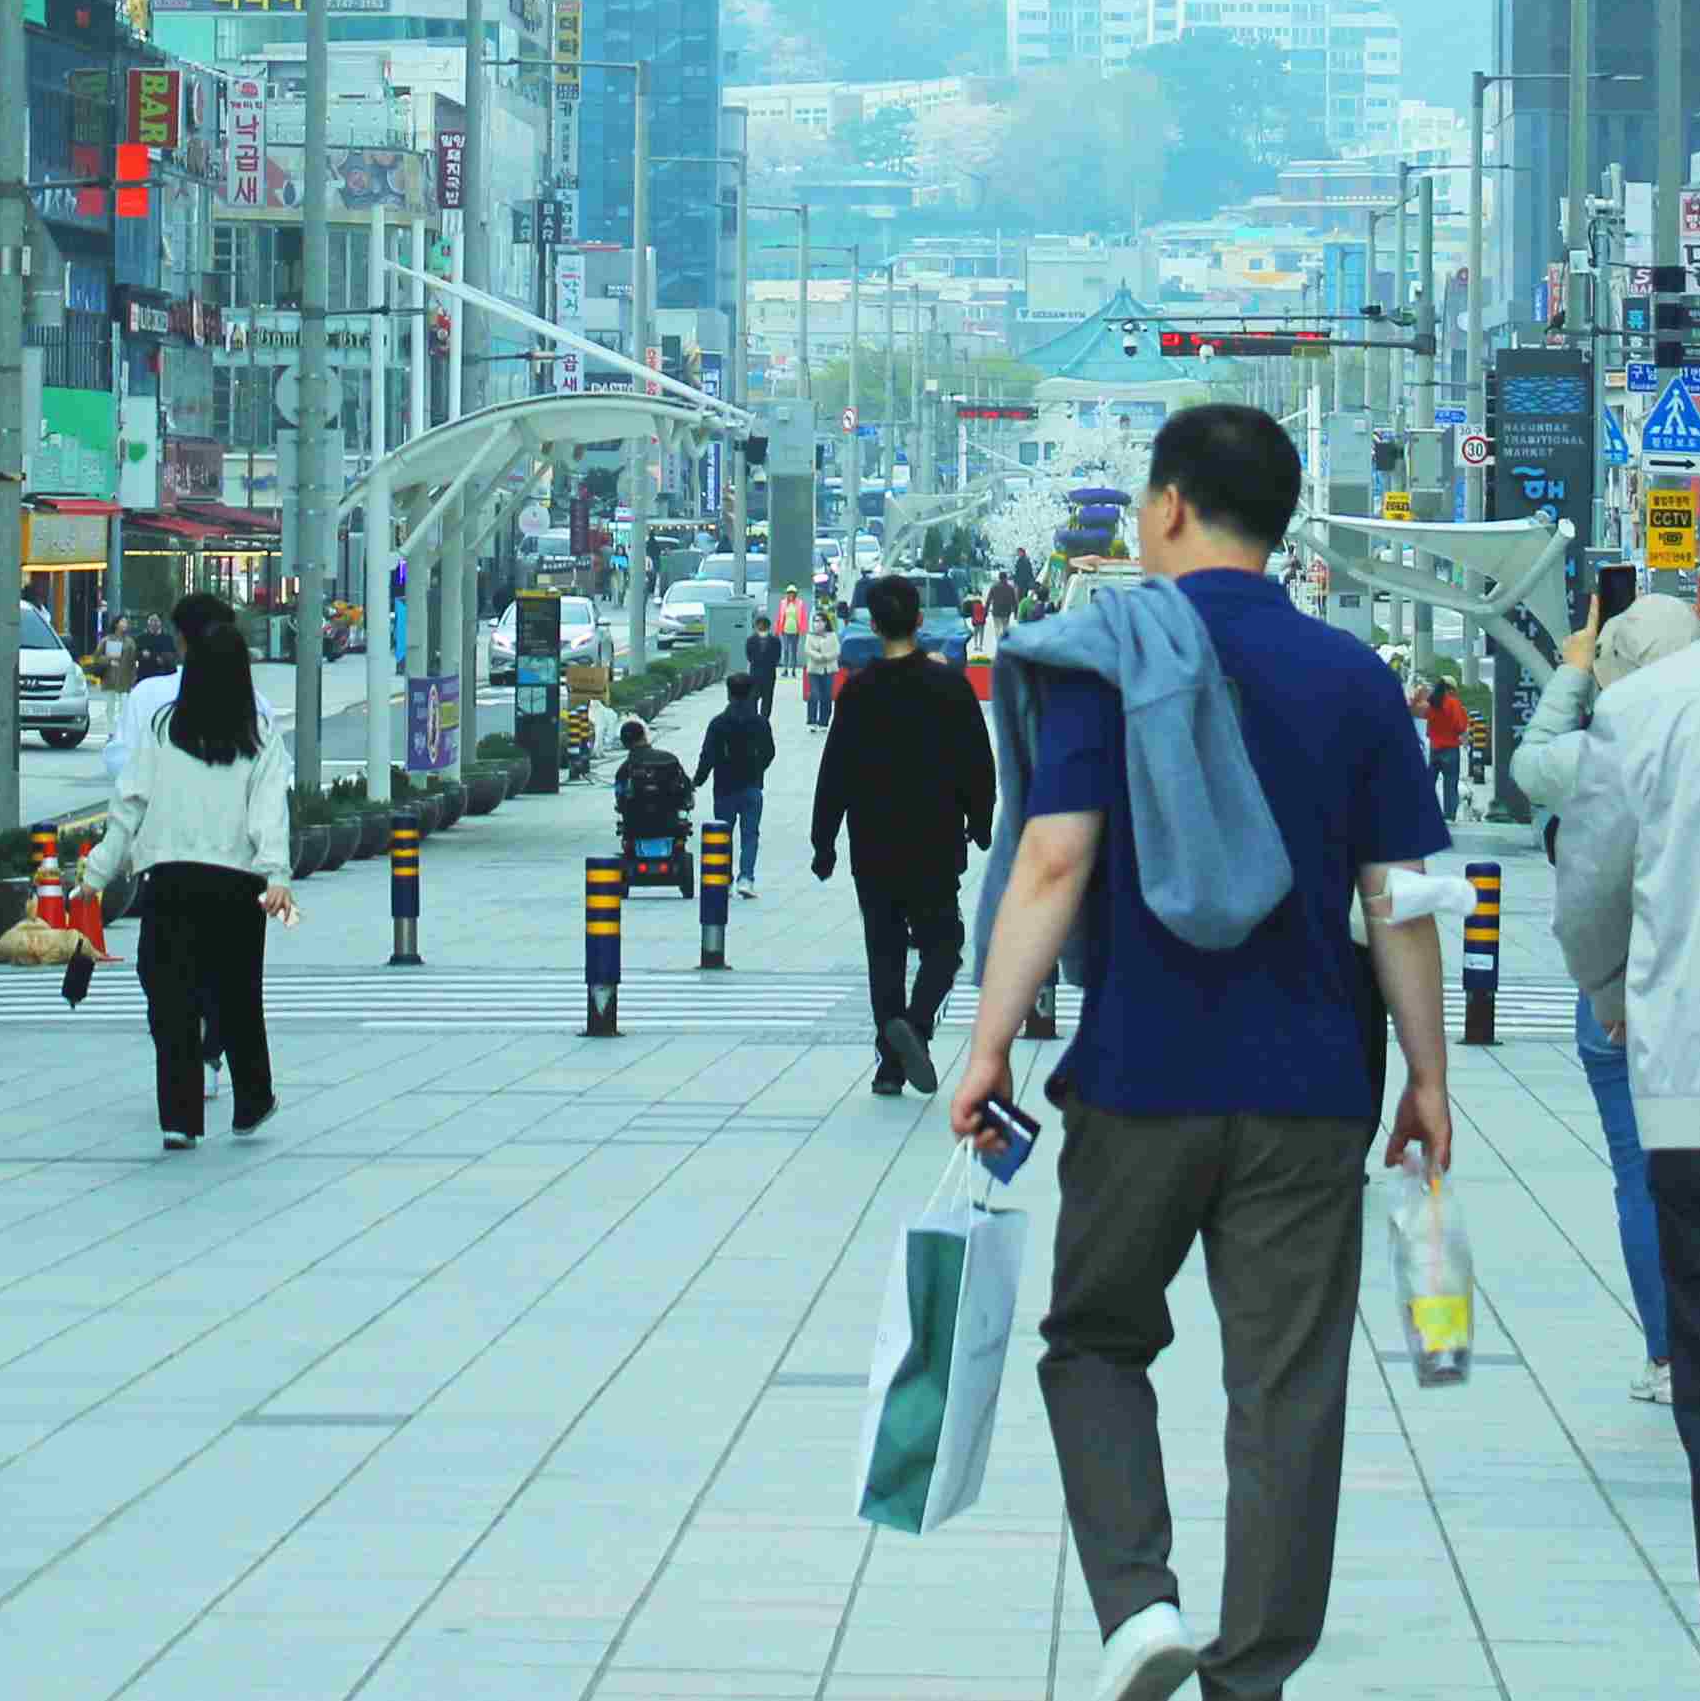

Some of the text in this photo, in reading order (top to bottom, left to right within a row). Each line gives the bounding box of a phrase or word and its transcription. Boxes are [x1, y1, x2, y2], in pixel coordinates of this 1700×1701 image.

[140, 73, 169, 143] BAR
[235, 114, 260, 205] 낙곱새
[541, 202, 555, 241] BAR
[1503, 434, 1585, 445] TRADITIONAL
[1467, 442, 1484, 458] 30
[1503, 447, 1554, 458] MARKET
[1652, 511, 1689, 526] CCTV
